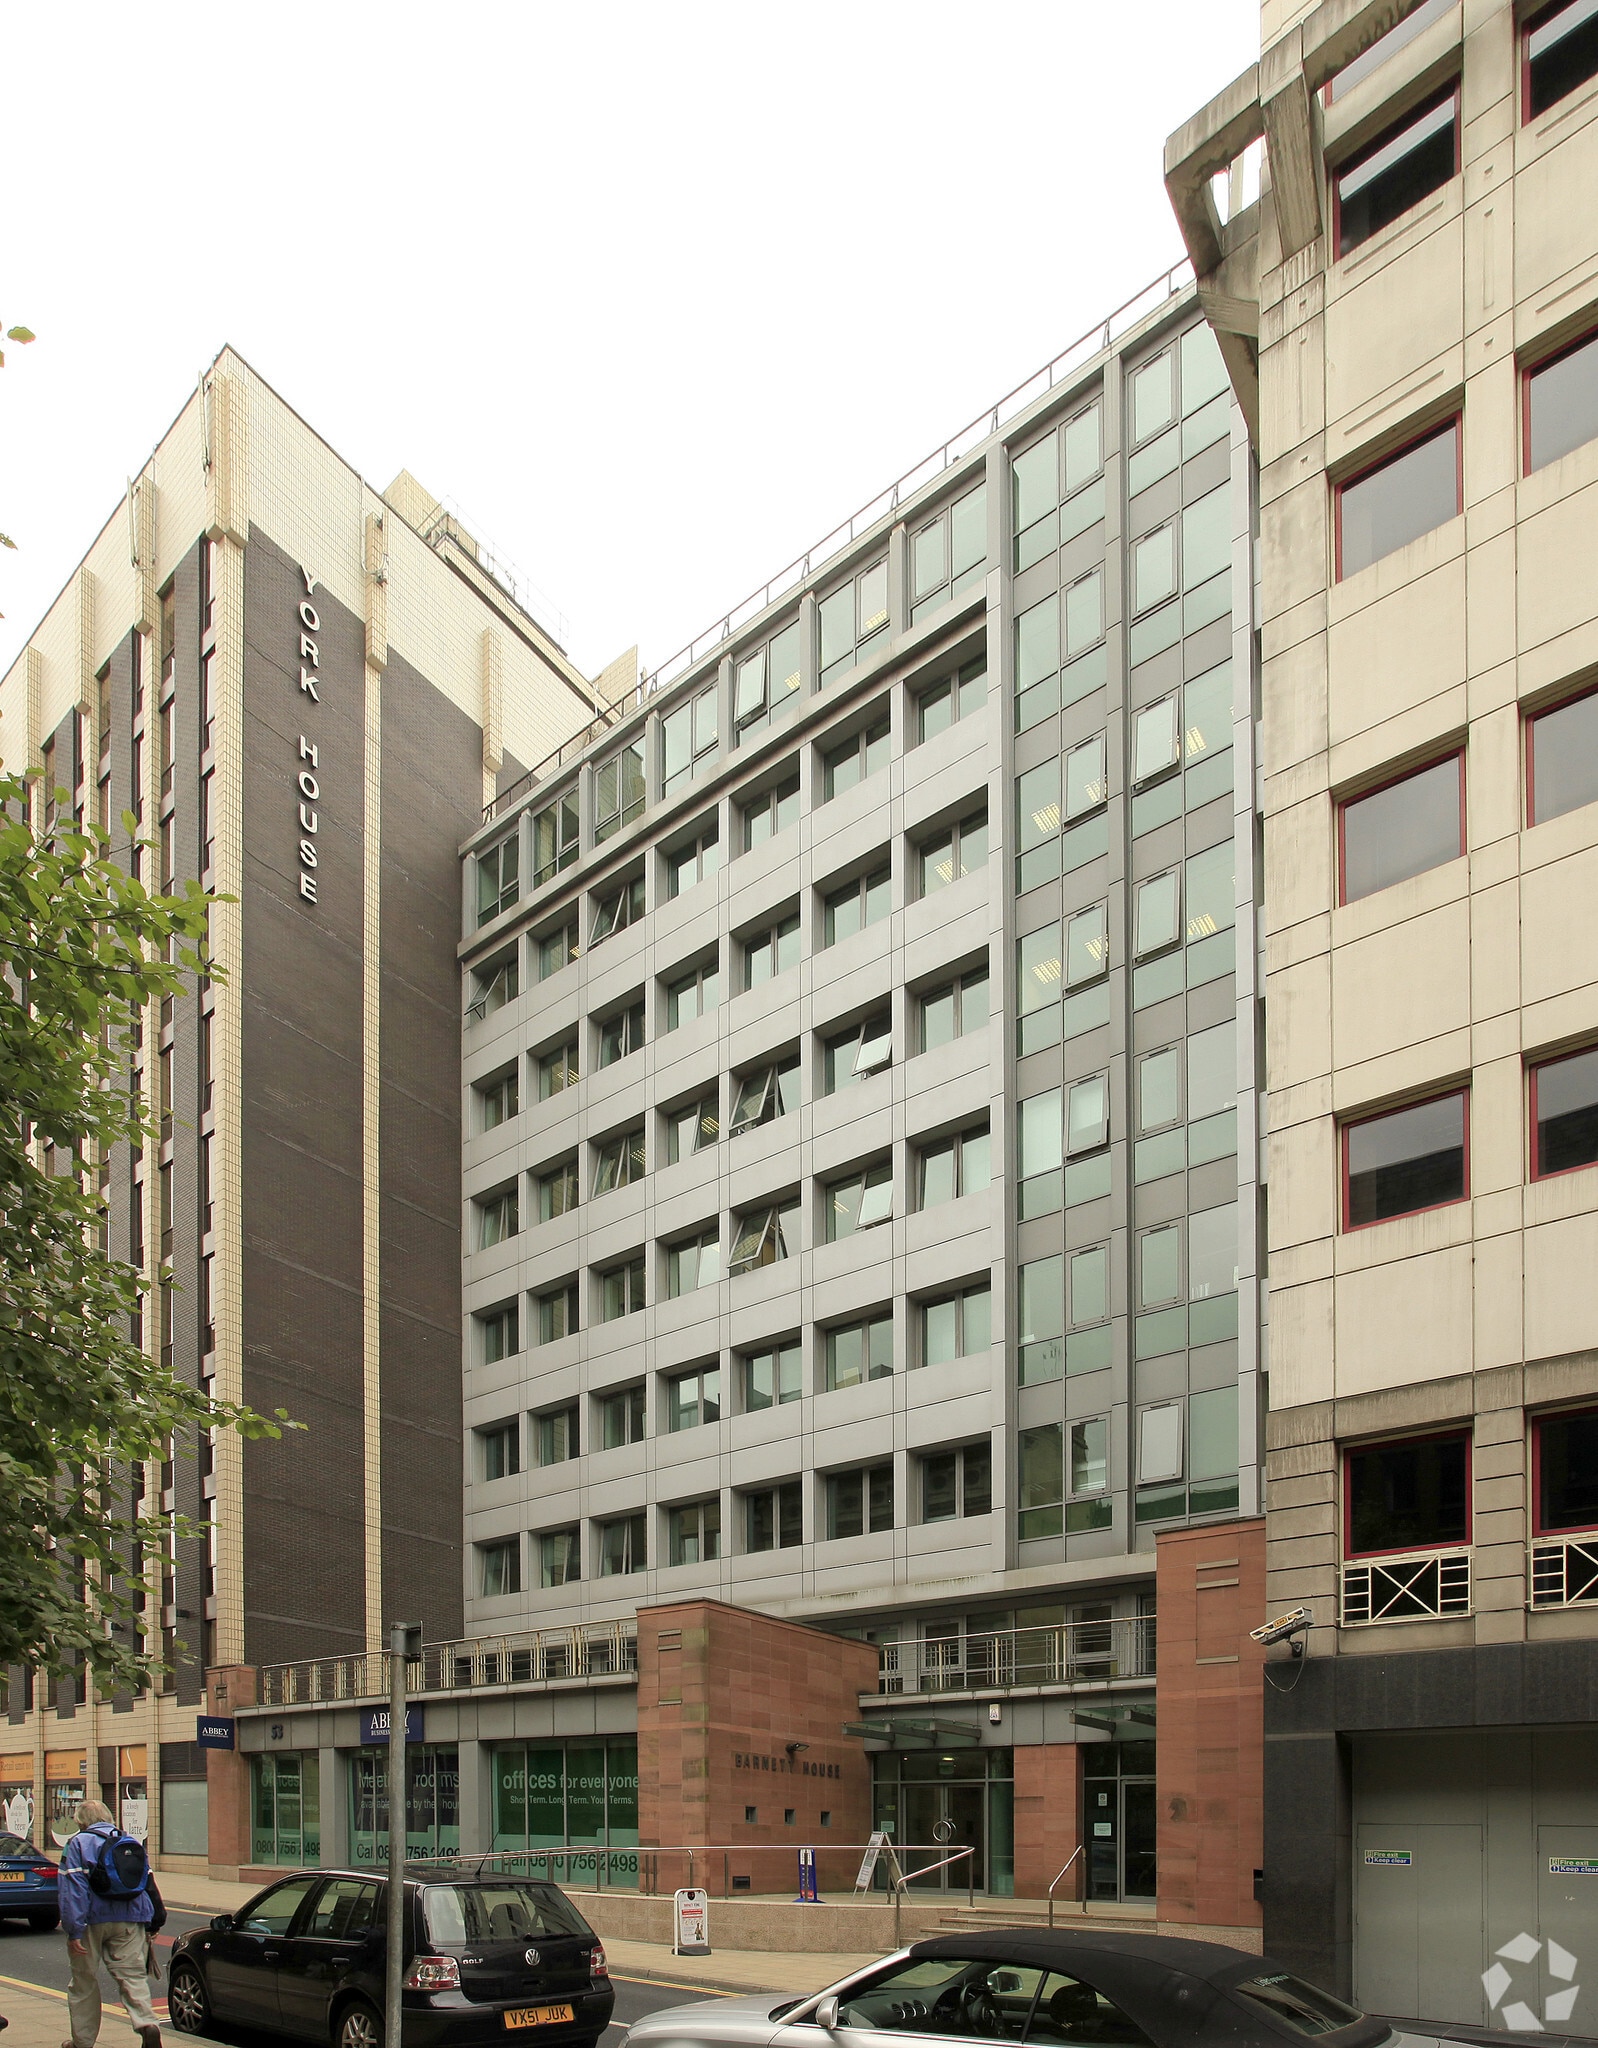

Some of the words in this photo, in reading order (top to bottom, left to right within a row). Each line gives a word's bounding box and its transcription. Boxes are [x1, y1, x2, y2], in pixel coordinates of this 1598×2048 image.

[299, 564, 321, 703] YORK
[299, 734, 321, 904] HOUSE
[370, 1711, 411, 1729] ABY
[202, 1727, 229, 1736] ABBEY
[271, 1725, 284, 1740] 53
[735, 1753, 795, 1775] BARNETT
[803, 1761, 840, 1779] HOUSE
[261, 1771, 299, 1788] Ofices
[503, 1770, 557, 1790] offces
[580, 1776, 638, 1792] everyone
[413, 1798, 423, 1811] by
[424, 1798, 435, 1809] the
[529, 1795, 548, 1804] Term.
[569, 1795, 589, 1804] Term.
[591, 1795, 605, 1804] You
[609, 1795, 634, 1805] Terms.
[280, 1840, 296, 1855] 756
[356, 1843, 374, 1859] Cal
[407, 1846, 428, 1860] 756
[572, 1853, 596, 1870] 756
[3, 1872, 20, 1880] XVT
[510, 2010, 540, 2026] VX51
[545, 2007, 568, 2021] JUK
